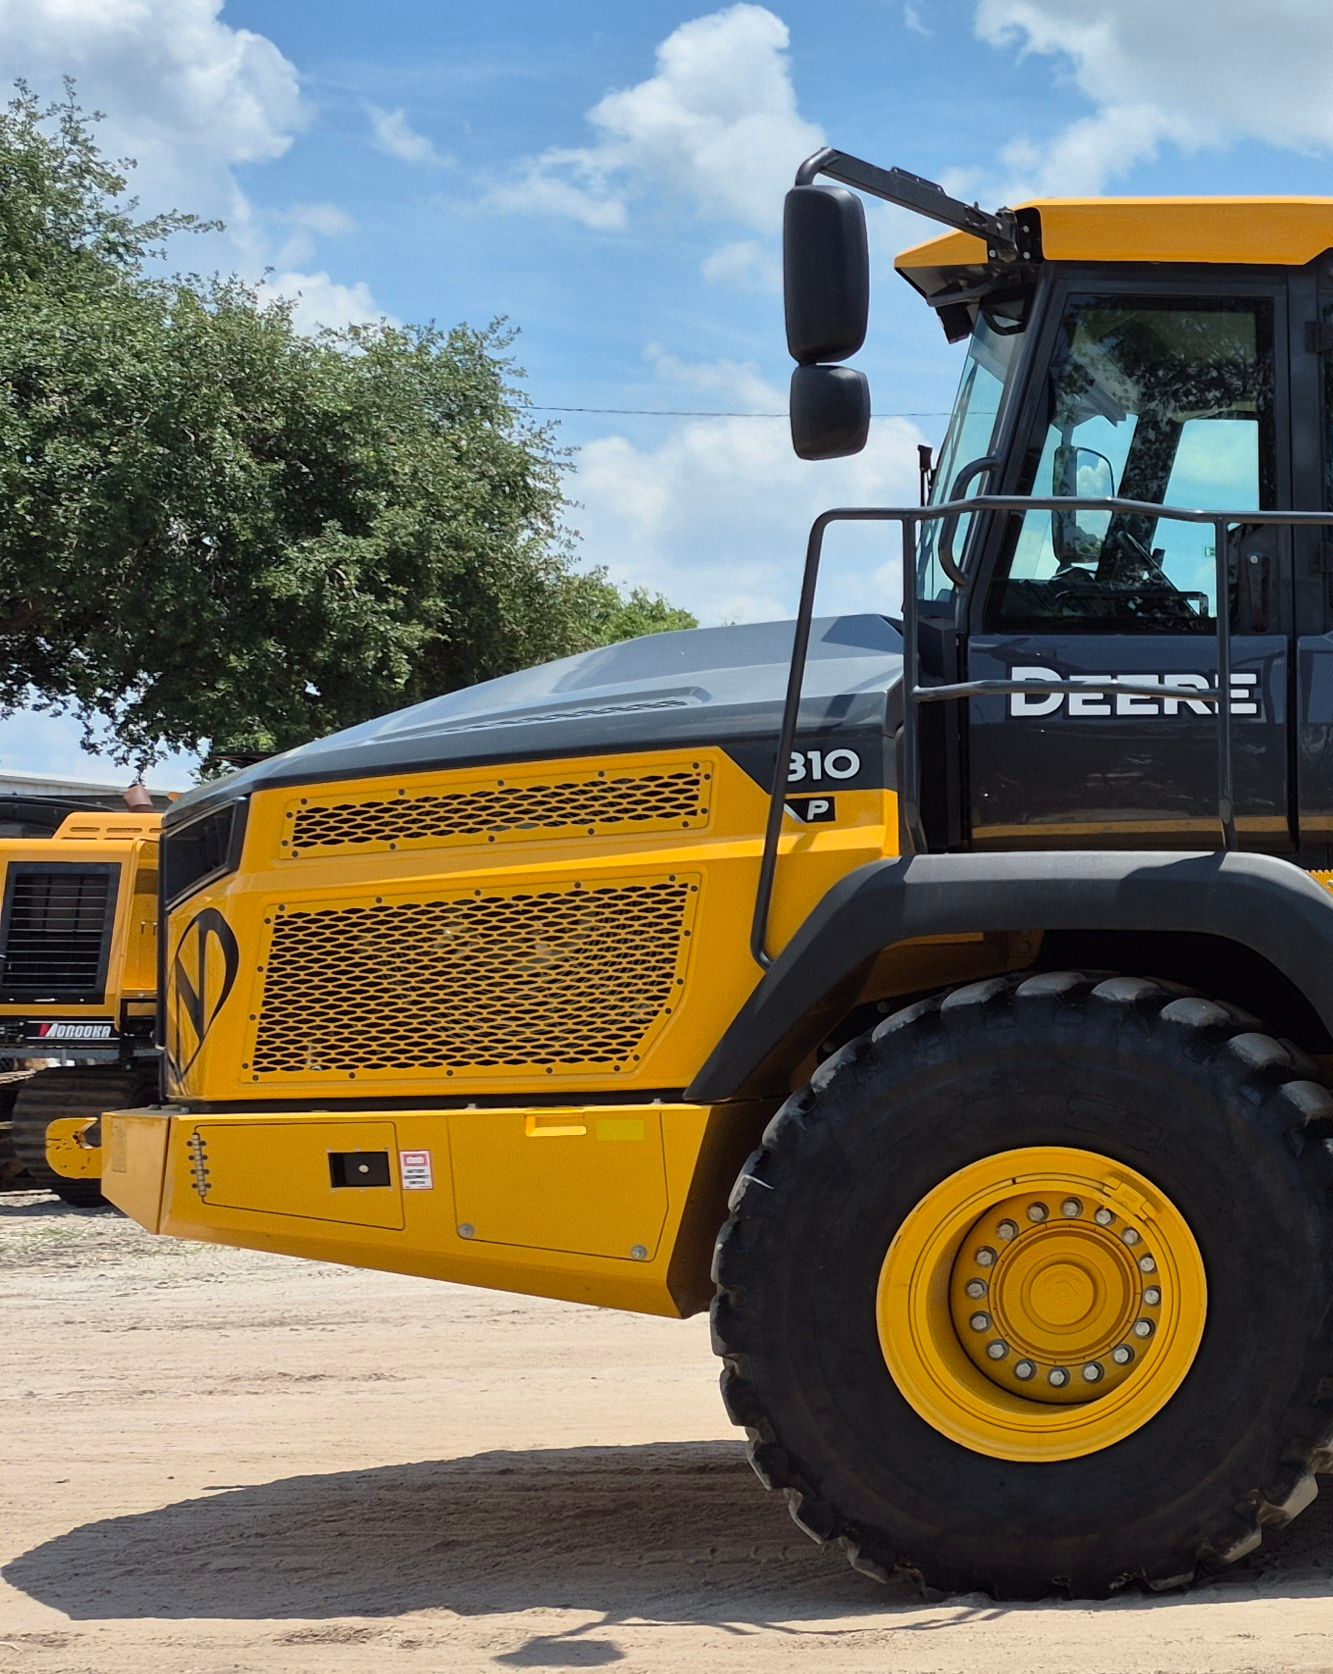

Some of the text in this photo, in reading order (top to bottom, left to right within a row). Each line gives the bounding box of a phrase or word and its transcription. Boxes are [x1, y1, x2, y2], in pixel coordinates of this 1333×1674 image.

[1011, 666, 1258, 717] DEERE
[787, 748, 860, 782] 310
[807, 800, 830, 820] P
